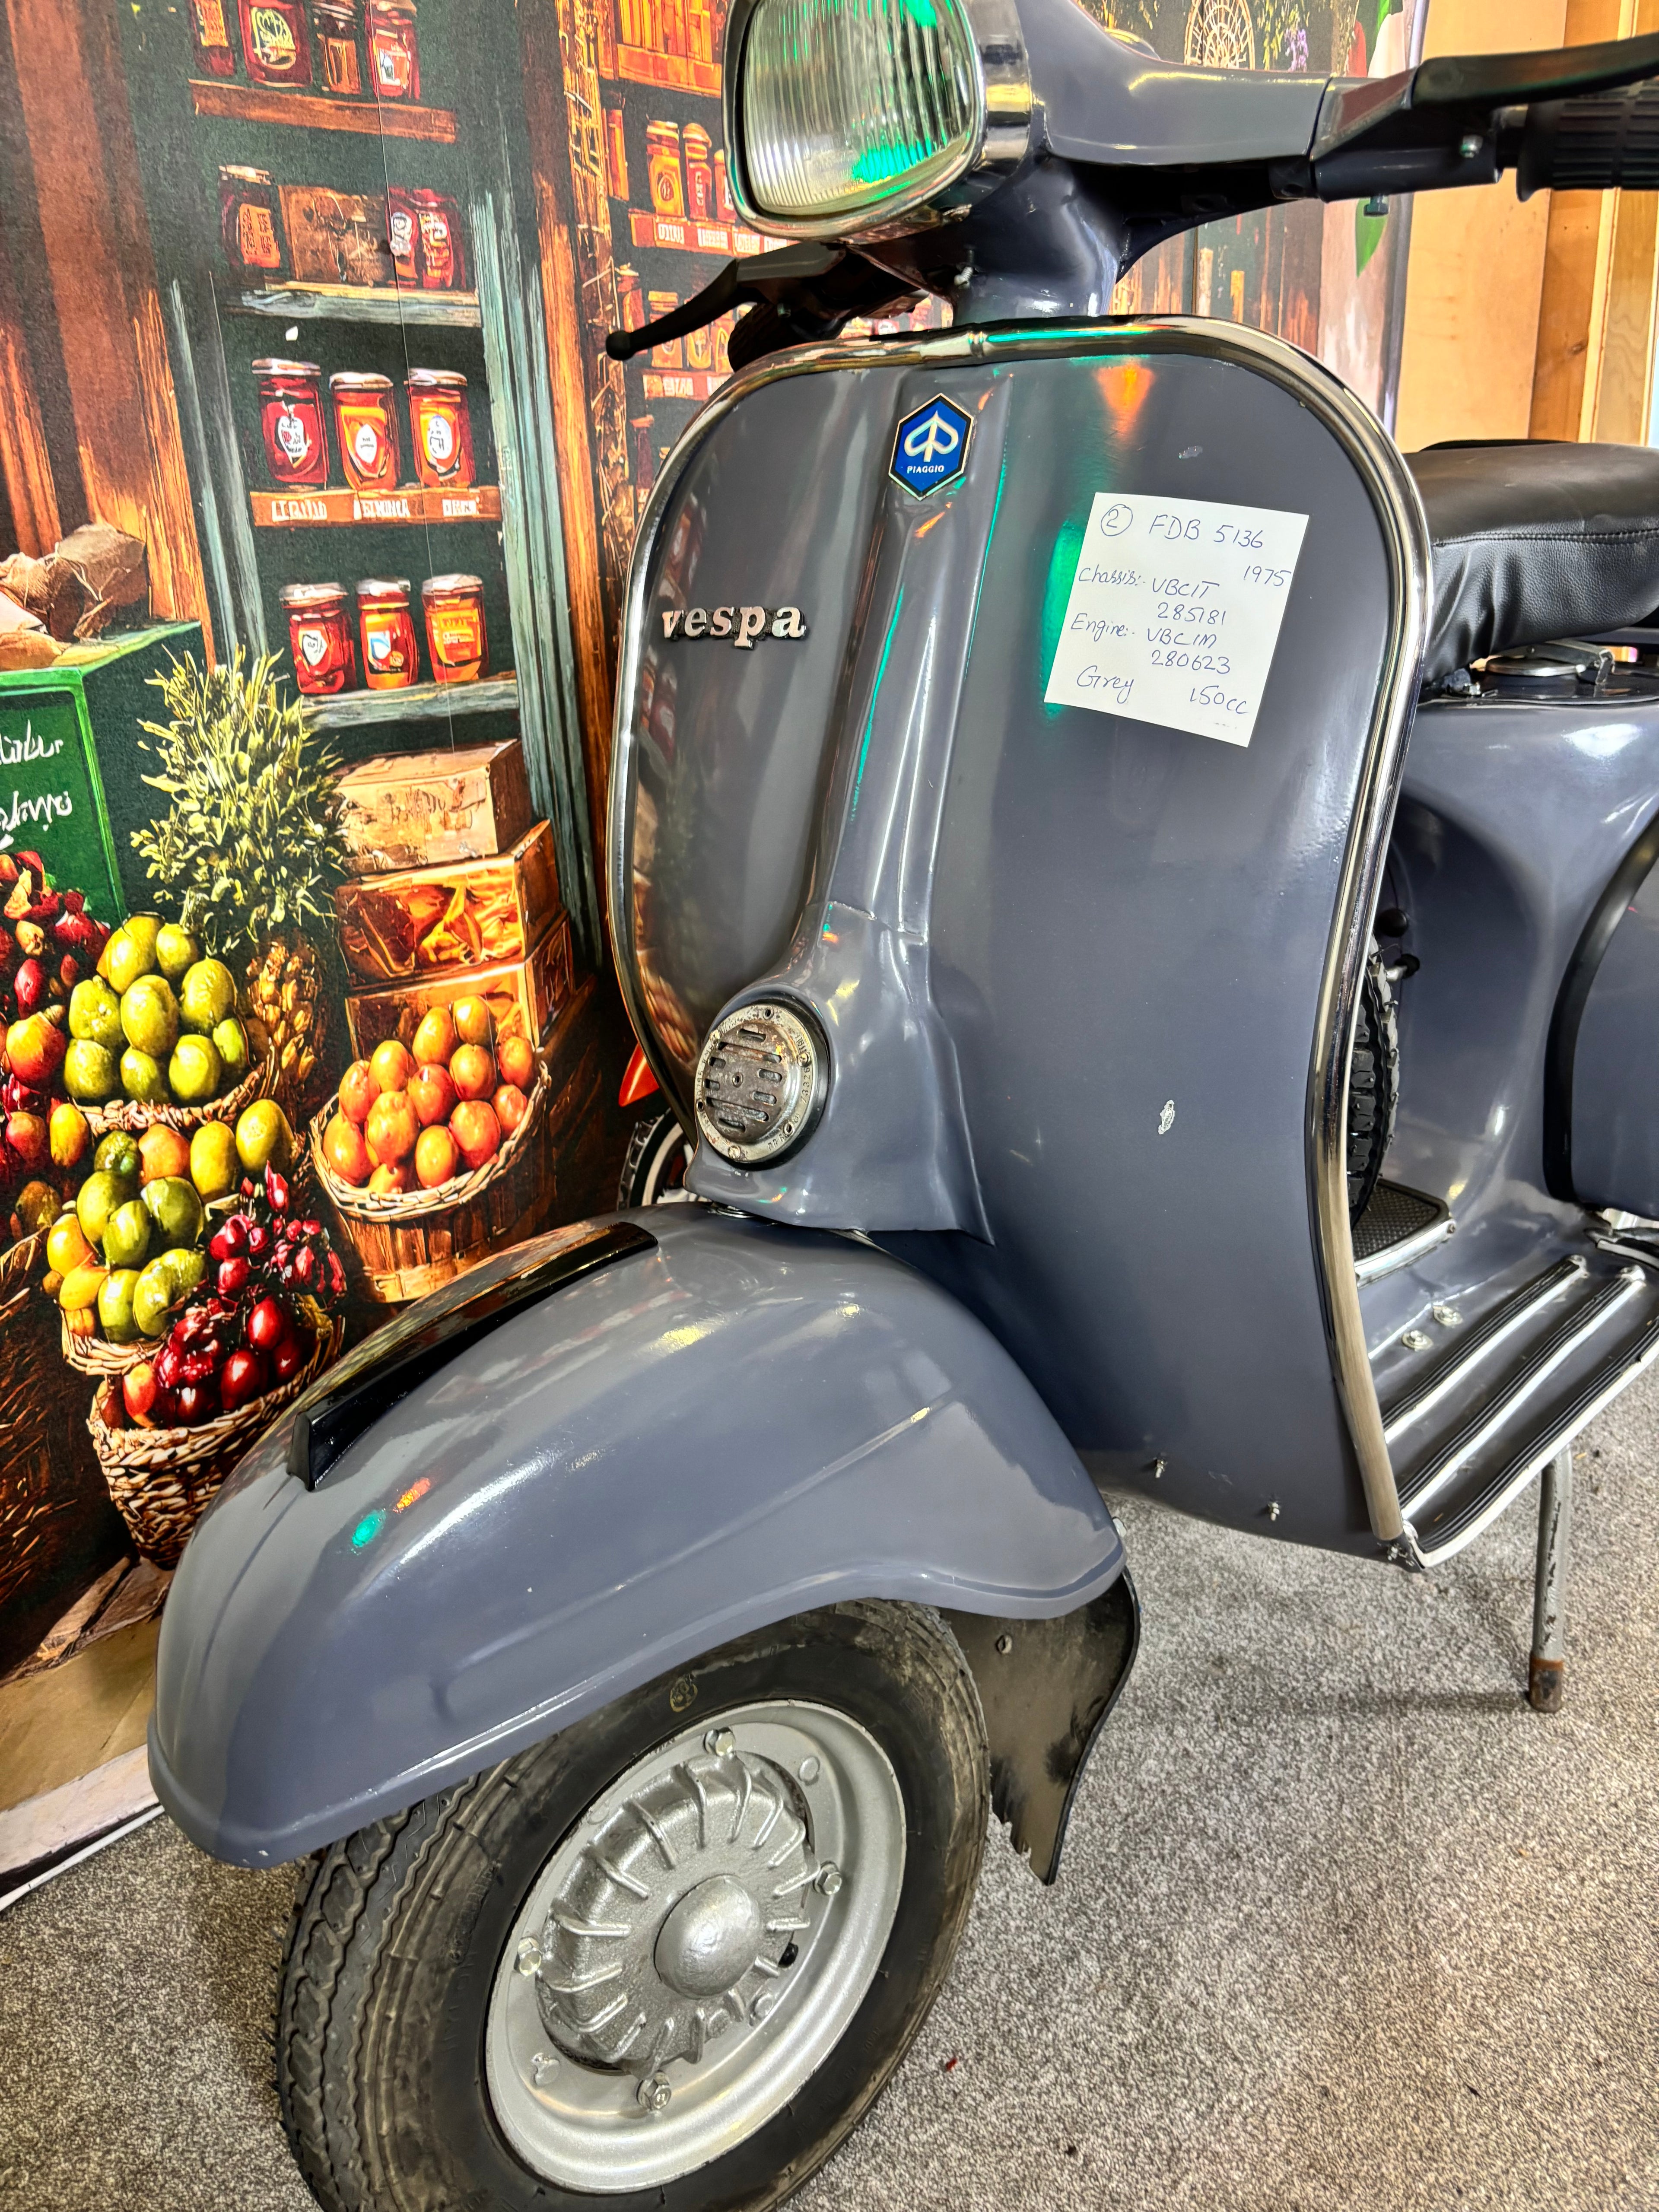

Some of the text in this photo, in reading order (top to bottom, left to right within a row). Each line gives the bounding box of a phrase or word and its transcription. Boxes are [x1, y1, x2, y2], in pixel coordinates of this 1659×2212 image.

[907, 465, 944, 474] PIAGGIO
[1149, 515, 1200, 540] FDB
[1214, 525, 1263, 548] 5136
[1244, 566, 1291, 586] 1975
[1158, 602, 1226, 625] 285181
[662, 606, 807, 648] vespa
[1152, 650, 1230, 674] 280623
[1077, 665, 1134, 704] Grey
